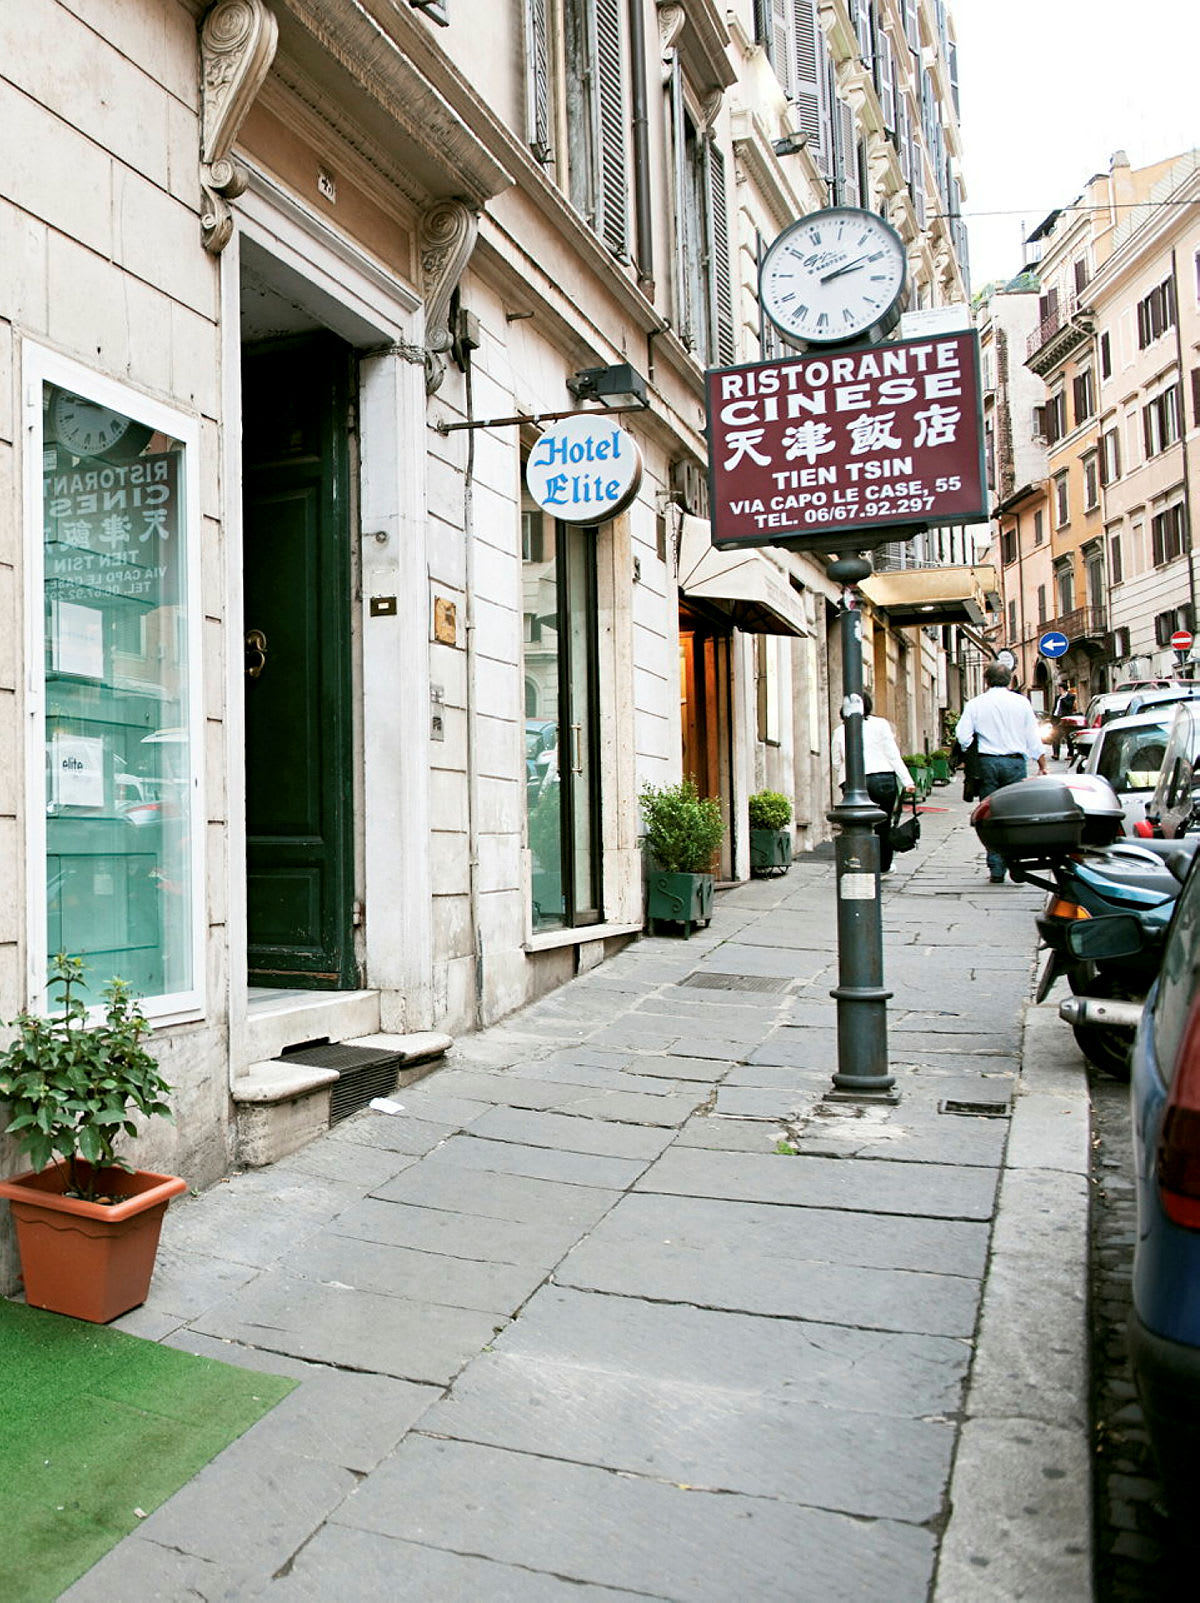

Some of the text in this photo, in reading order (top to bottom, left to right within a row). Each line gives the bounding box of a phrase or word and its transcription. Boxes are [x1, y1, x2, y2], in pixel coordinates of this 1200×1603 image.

[721, 341, 959, 400] RISTORANTE
[720, 370, 962, 426] CINESE
[534, 430, 621, 466] Hotel
[723, 404, 961, 471] 天津飯店
[541, 473, 620, 505] Elite
[772, 456, 913, 490] TIEN TSIN
[729, 475, 962, 515] VIA CAPO LE CASE, 55
[754, 496, 935, 529] TEL. 06/67.92.297
